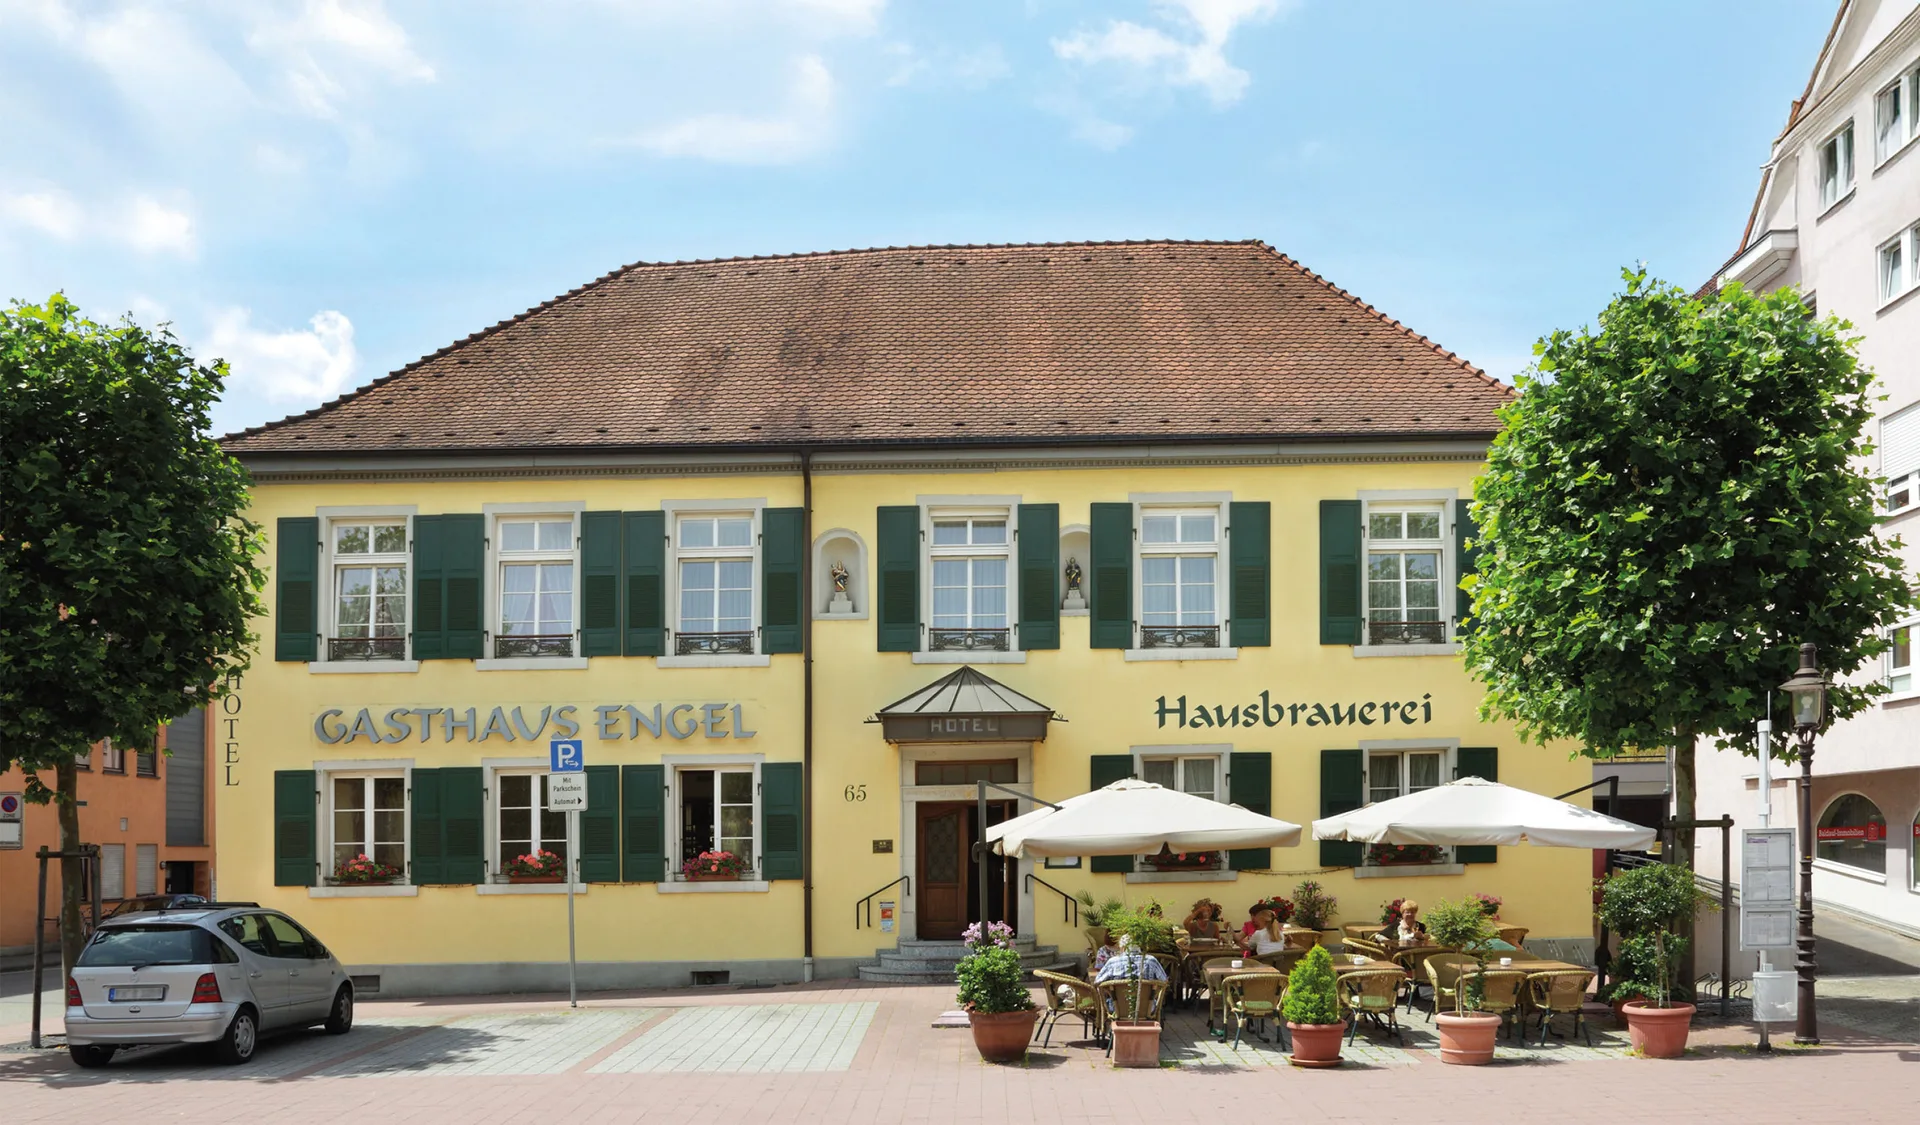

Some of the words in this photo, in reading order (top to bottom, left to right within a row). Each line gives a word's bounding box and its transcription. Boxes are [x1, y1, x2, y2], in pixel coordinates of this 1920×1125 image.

[314, 704, 579, 744] GASTHAUS
[594, 702, 757, 741] ENGEL
[1154, 689, 1432, 729] Hausbrauerei
[223, 668, 242, 787] HOTEL
[930, 718, 998, 733] HOTEL
[557, 744, 576, 769] P
[844, 784, 867, 802] 65
